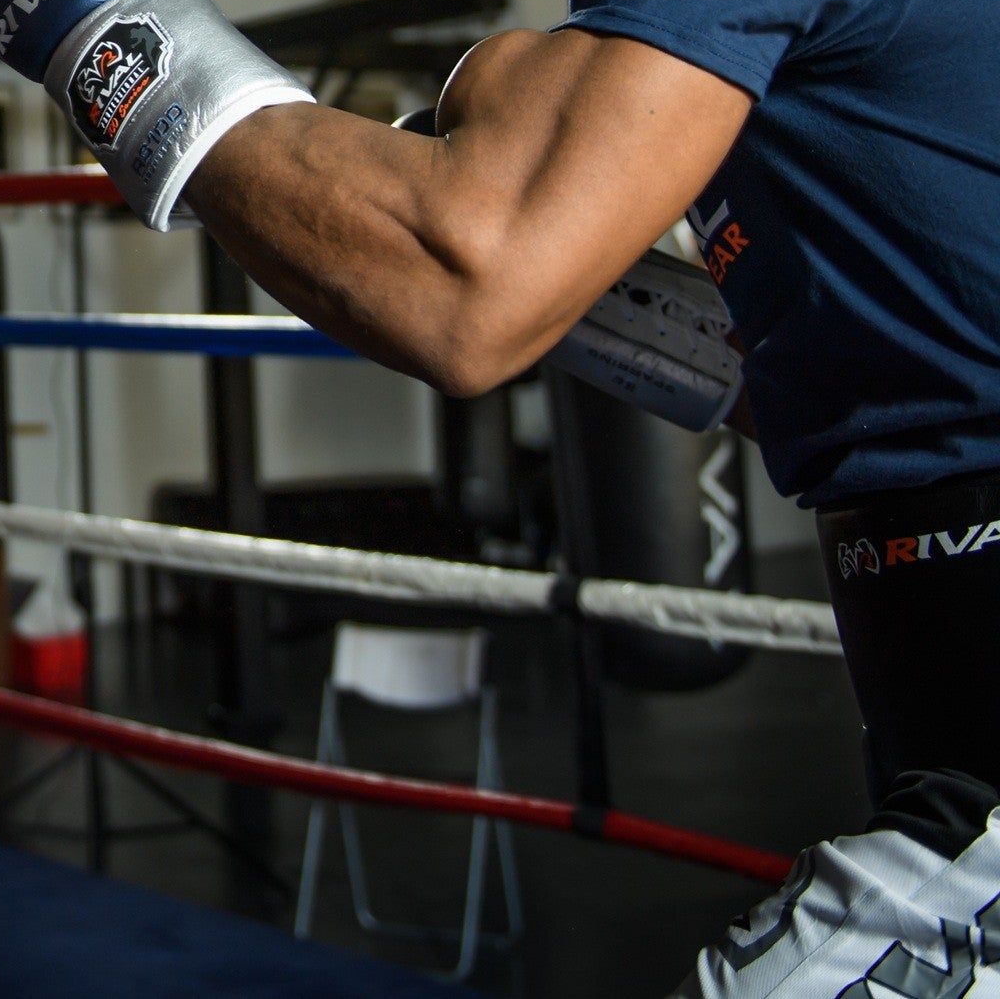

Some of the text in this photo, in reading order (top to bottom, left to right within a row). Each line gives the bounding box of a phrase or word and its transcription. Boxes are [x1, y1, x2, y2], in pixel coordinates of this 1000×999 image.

[101, 67, 145, 129] PROFESSIONAL
[708, 222, 750, 285] EAR
[886, 519, 1000, 566] RIVA
